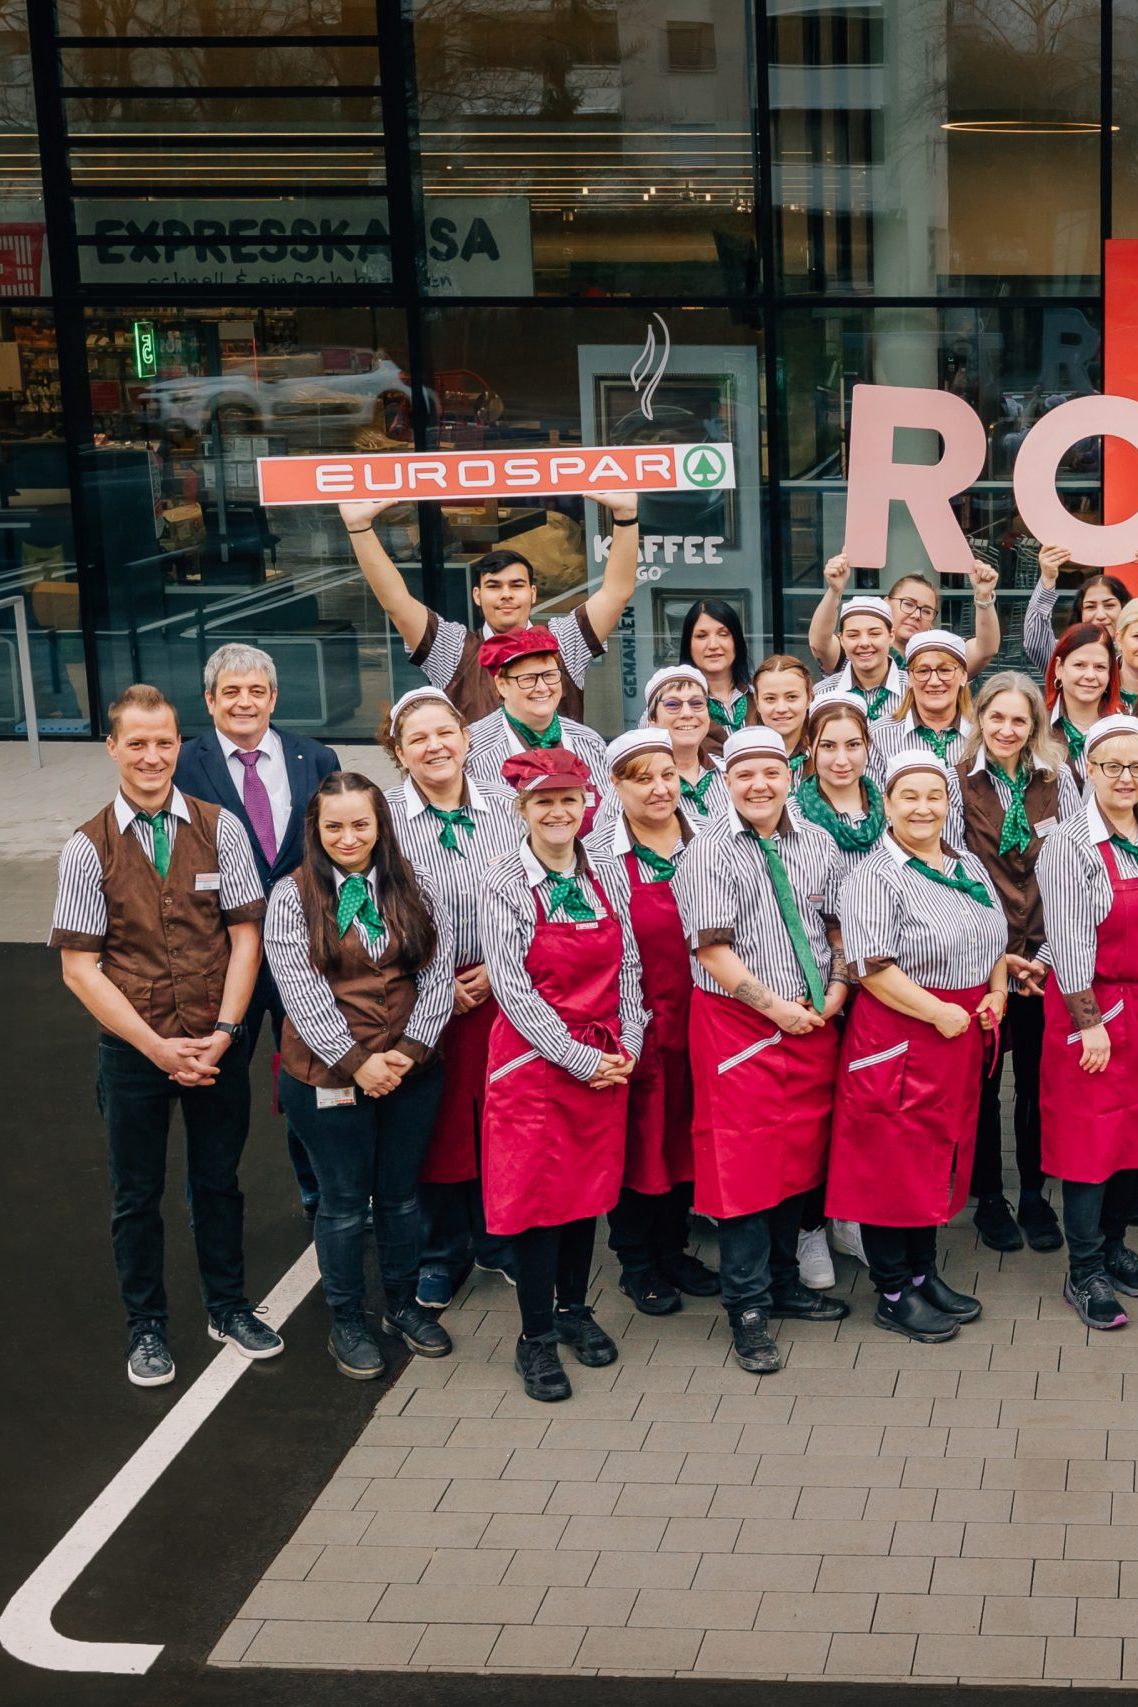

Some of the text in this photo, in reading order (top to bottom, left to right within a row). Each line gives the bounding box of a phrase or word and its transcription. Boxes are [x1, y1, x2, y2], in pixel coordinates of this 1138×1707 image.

[94, 217, 500, 263] EXPRESSKASA
[315, 455, 672, 493] EUROSPAR
[593, 534, 725, 564] KFFEE
[635, 565, 662, 581] GO
